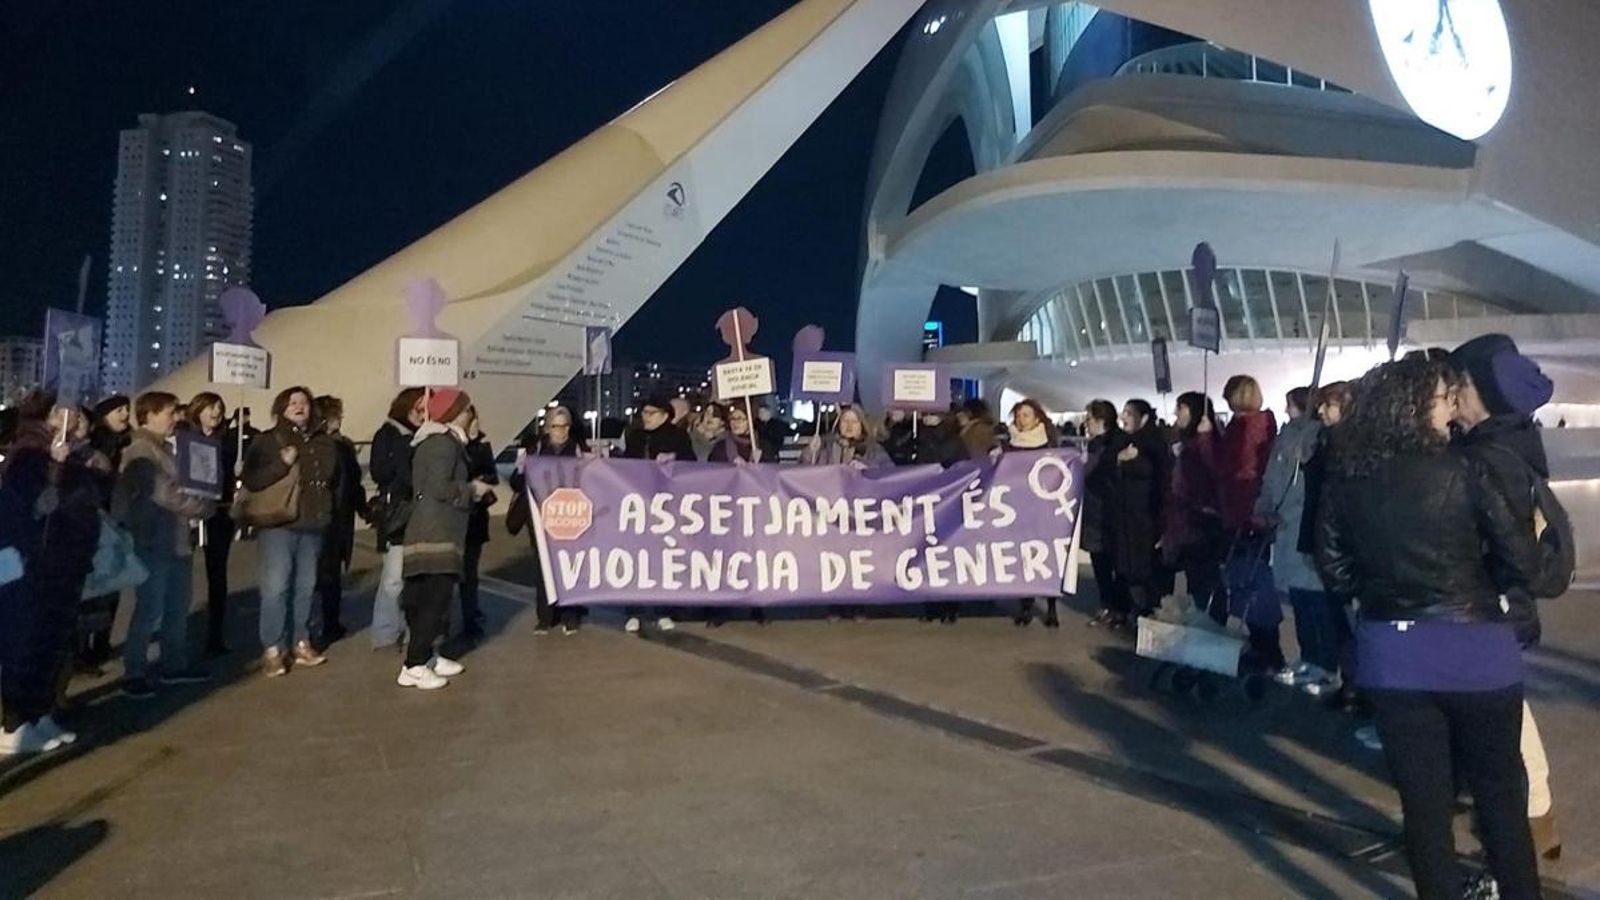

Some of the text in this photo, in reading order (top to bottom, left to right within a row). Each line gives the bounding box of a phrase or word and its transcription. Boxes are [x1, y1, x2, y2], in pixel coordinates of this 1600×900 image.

[409, 354, 451, 366] NO ÉS NO
[547, 501, 588, 516] STOP
[619, 478, 1016, 537] ASSETJAMENT ÉS
[558, 535, 799, 592] VIOLÈNCIA
[820, 550, 875, 592] DE
